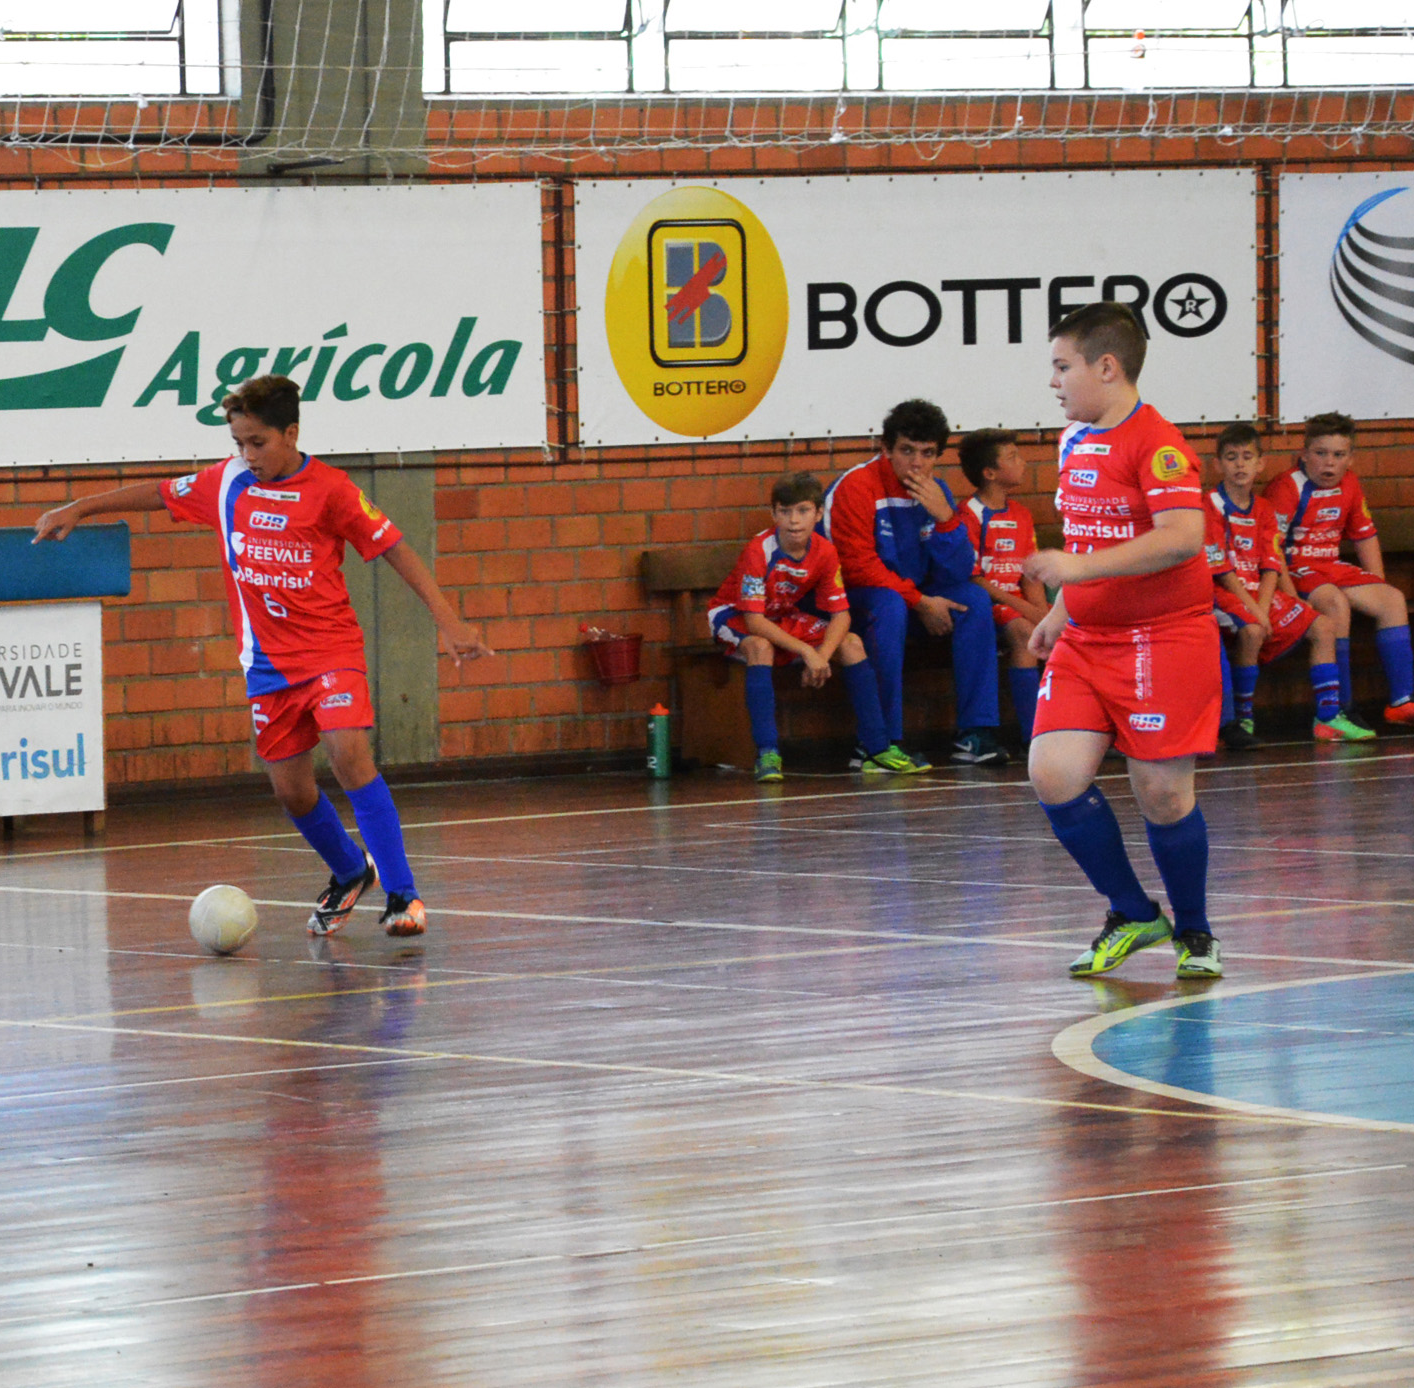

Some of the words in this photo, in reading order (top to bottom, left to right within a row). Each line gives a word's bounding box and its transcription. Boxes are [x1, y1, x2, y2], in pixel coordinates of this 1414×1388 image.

[807, 272, 1228, 350] BOTTERO
[133, 316, 523, 426] Agrícola
[653, 380, 746, 396] BOTTERO
[1063, 518, 1135, 539] Banrisul
[247, 544, 314, 564] FEEVALE
[54, 701, 83, 710] MUNDO
